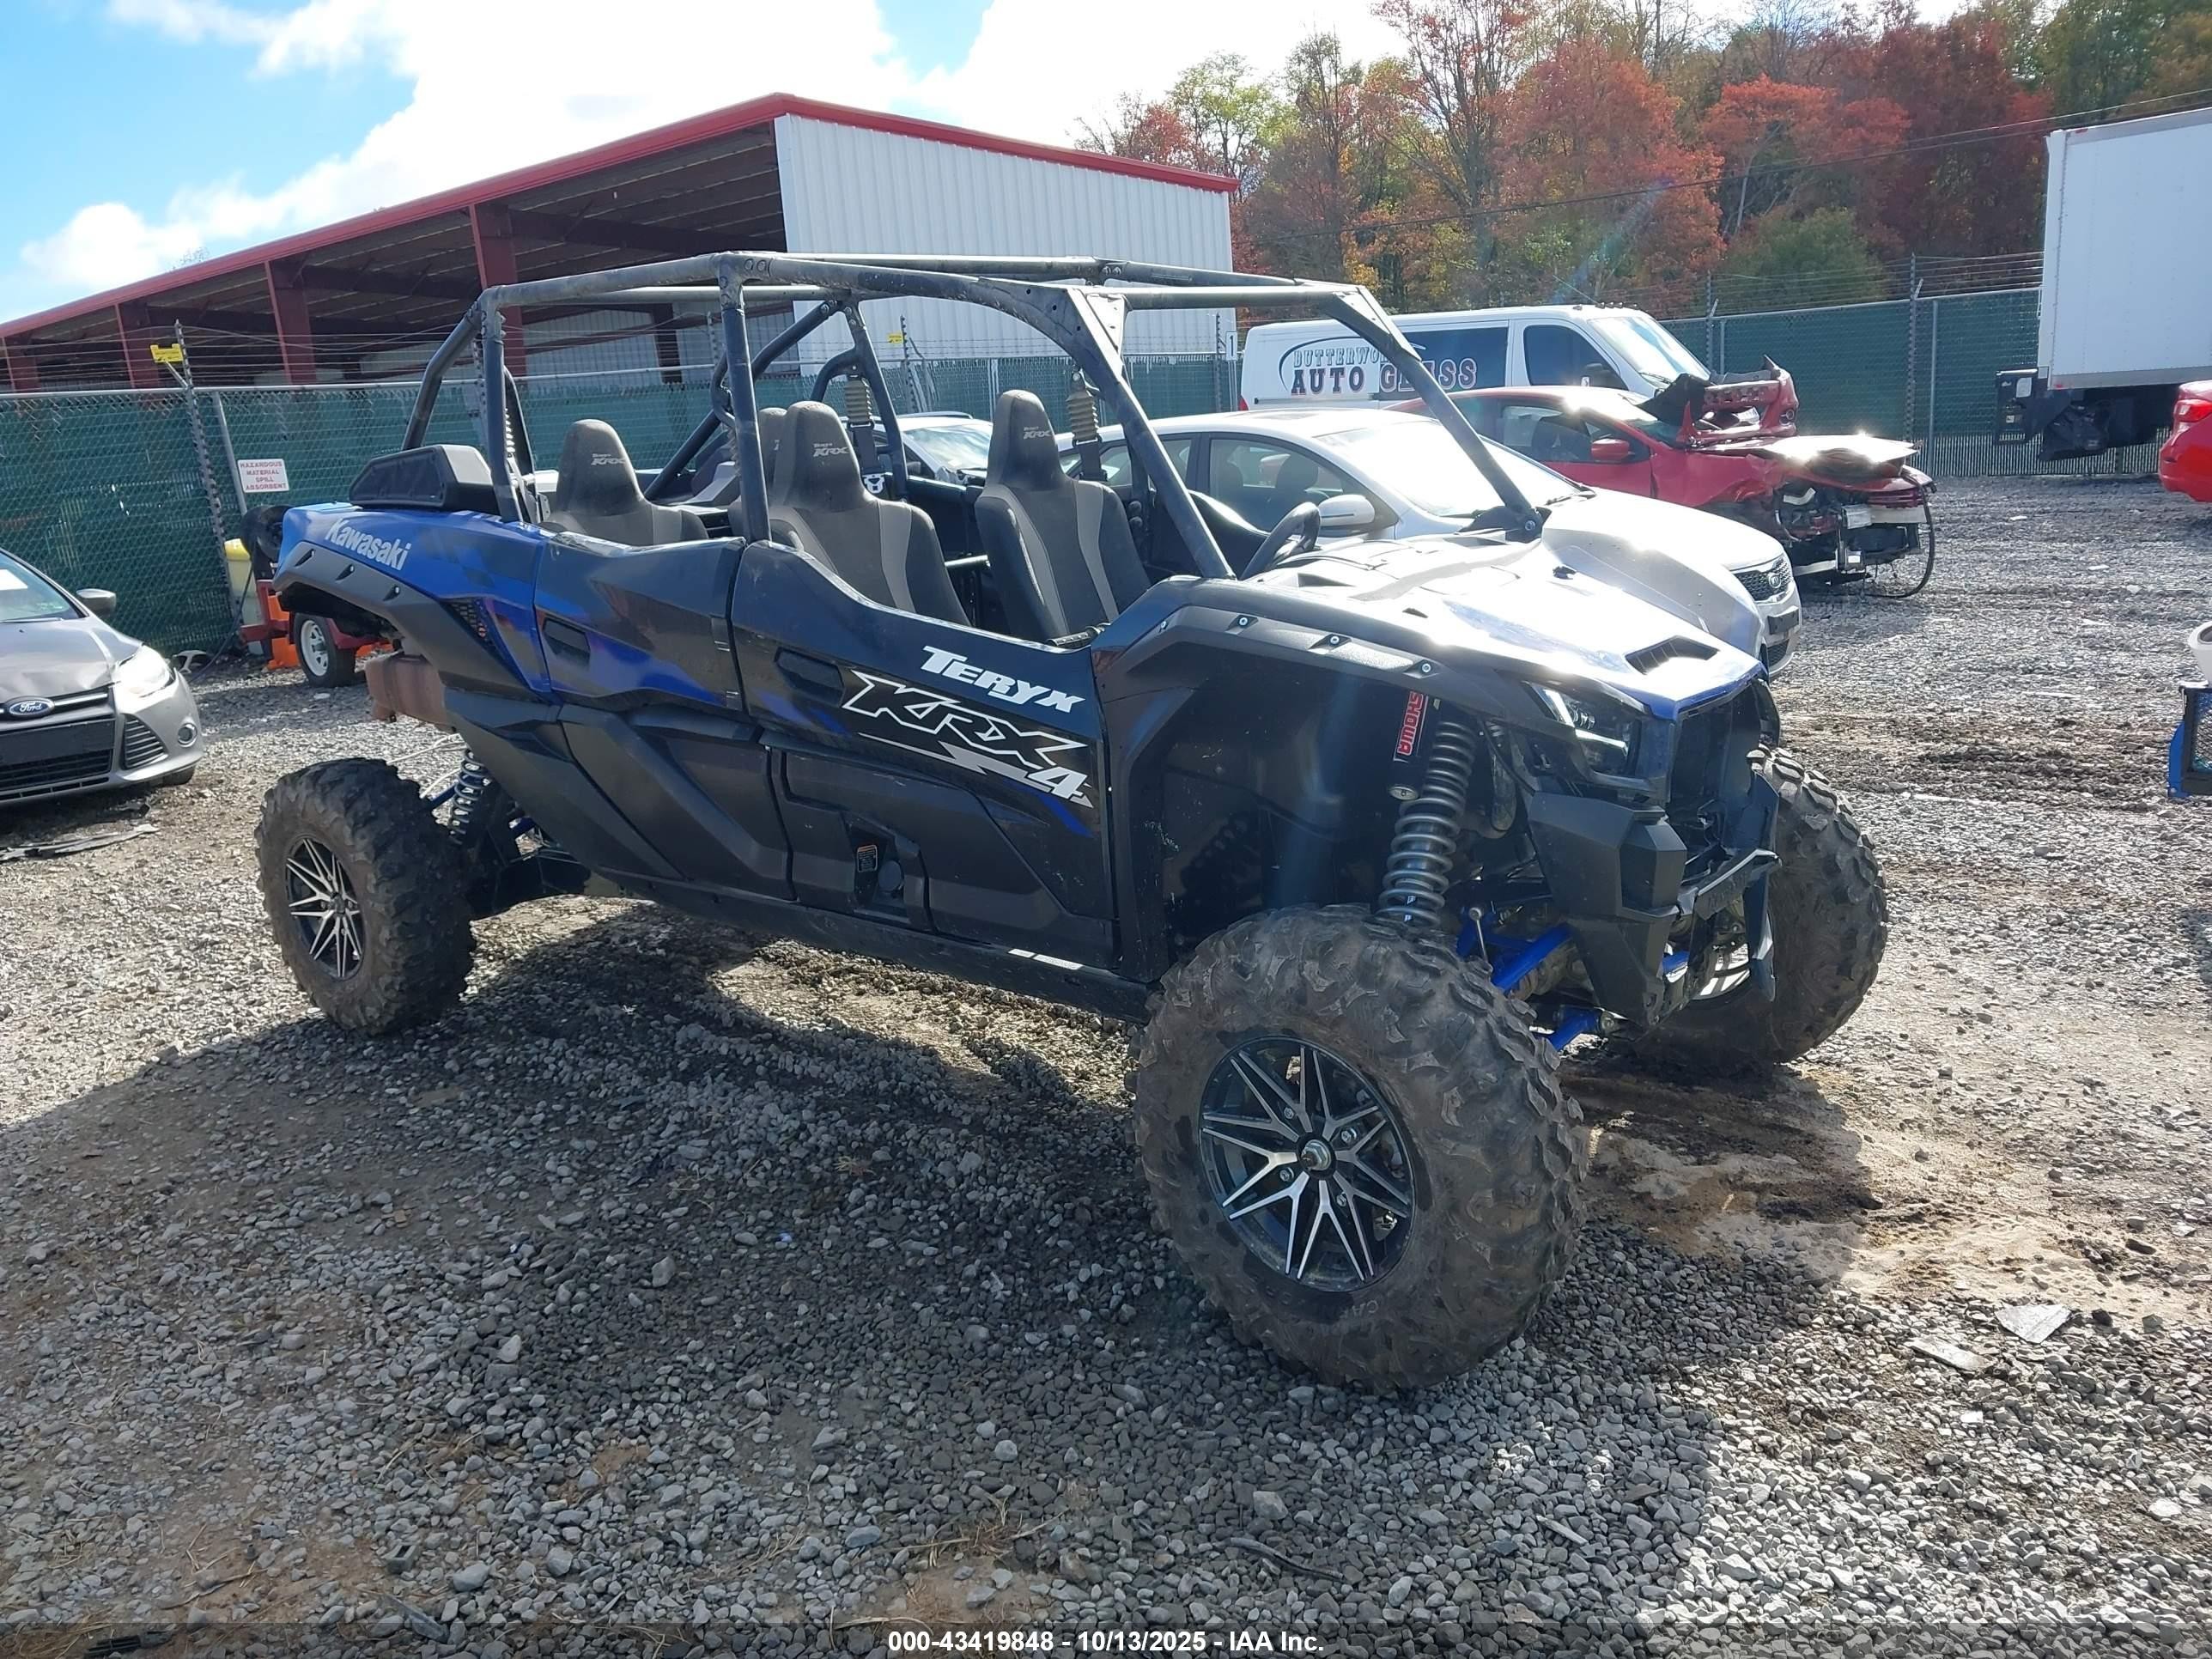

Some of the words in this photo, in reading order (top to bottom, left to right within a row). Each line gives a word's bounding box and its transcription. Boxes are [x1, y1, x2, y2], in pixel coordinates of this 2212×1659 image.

[1230, 335, 1234, 357] 1
[1291, 366, 1365, 396] AUTO
[1379, 357, 1478, 392] GLSS
[325, 518, 412, 571] Kawasaki
[921, 646, 1086, 714] TERYX
[19, 702, 42, 712] Ford
[1396, 690, 1424, 757] SHOWA
